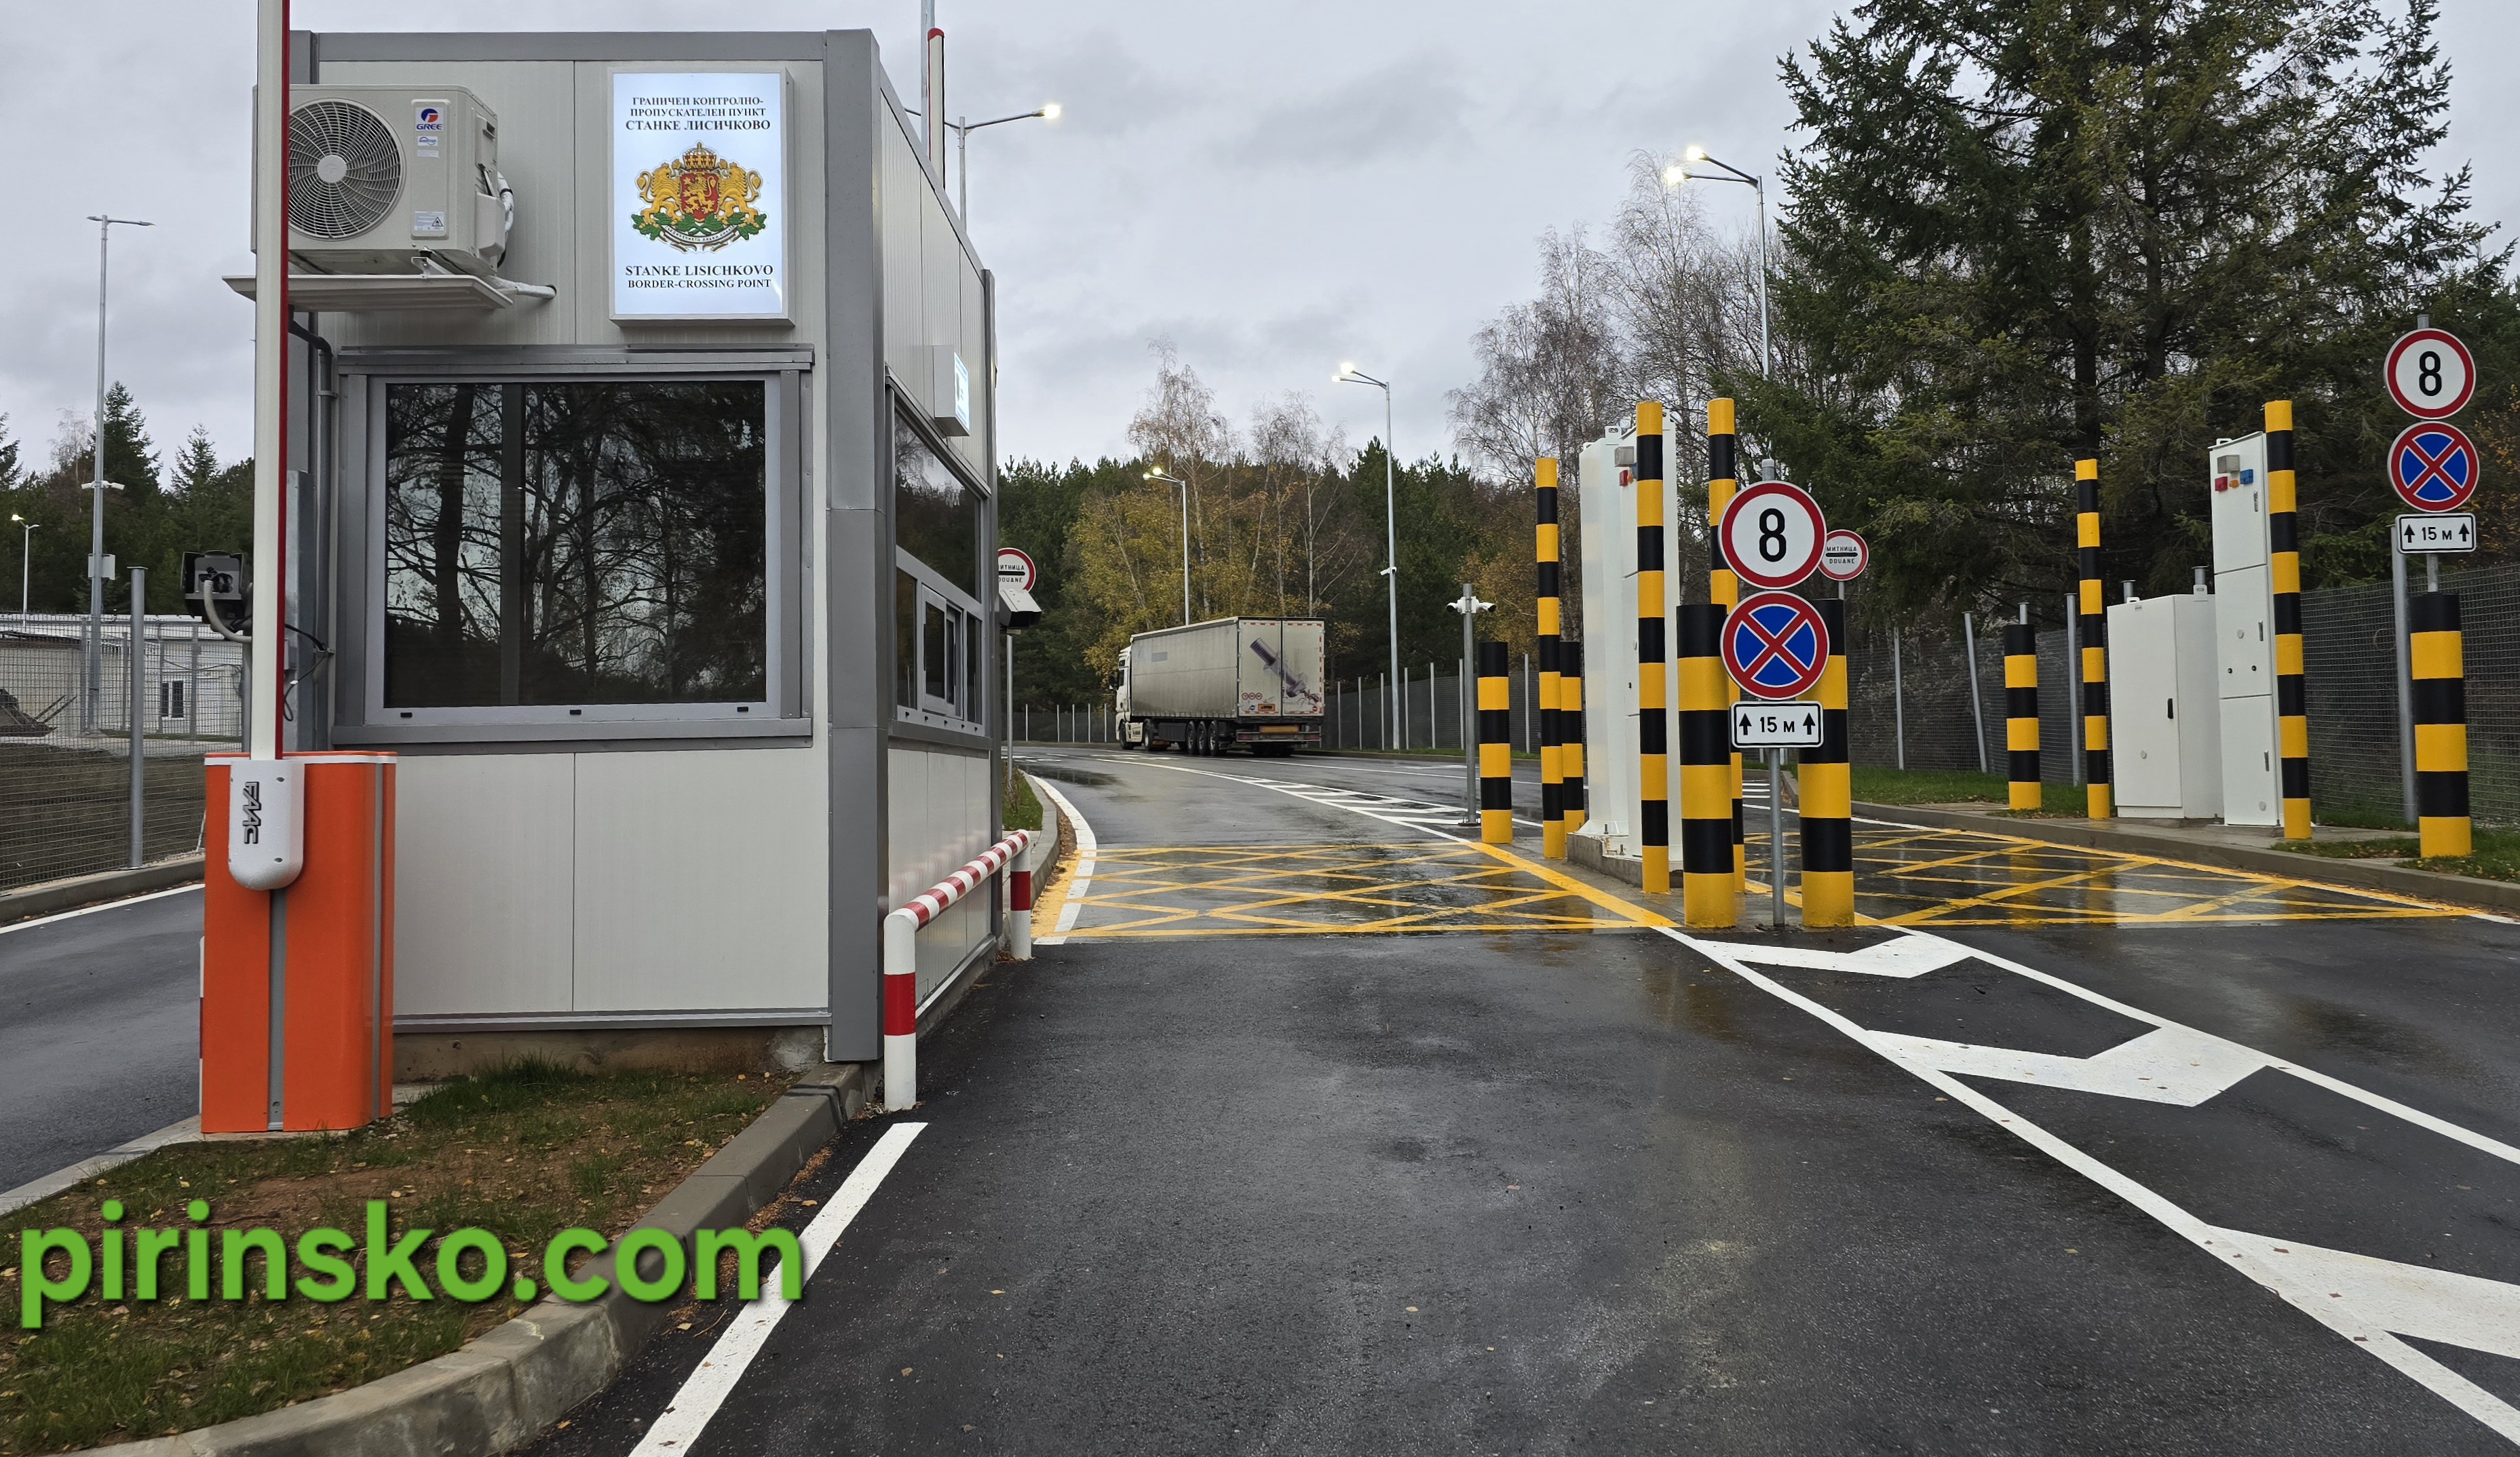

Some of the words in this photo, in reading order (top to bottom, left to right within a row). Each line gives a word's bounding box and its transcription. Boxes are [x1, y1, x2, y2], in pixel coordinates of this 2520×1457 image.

[632, 97, 690, 105] ГРАНИЧЕН
[693, 97, 763, 105] КОНТРОЛНО-
[630, 109, 725, 117] ПРОПУСКАТЕЛЕН
[729, 108, 766, 116] ПУНКТ
[626, 120, 681, 130] СТАНКЕ
[684, 119, 771, 130] ЛИСИЧКОВО
[625, 265, 681, 276] STANKE
[685, 265, 774, 276] LISICHKOVO
[628, 279, 735, 288] BORDER-CROSSING
[738, 279, 771, 288] POINT
[2419, 351, 2442, 397] 8
[1759, 507, 1787, 562] 8
[2422, 526, 2437, 541] 15
[1759, 716, 1778, 733] 15
[242, 781, 262, 844] FAAC
